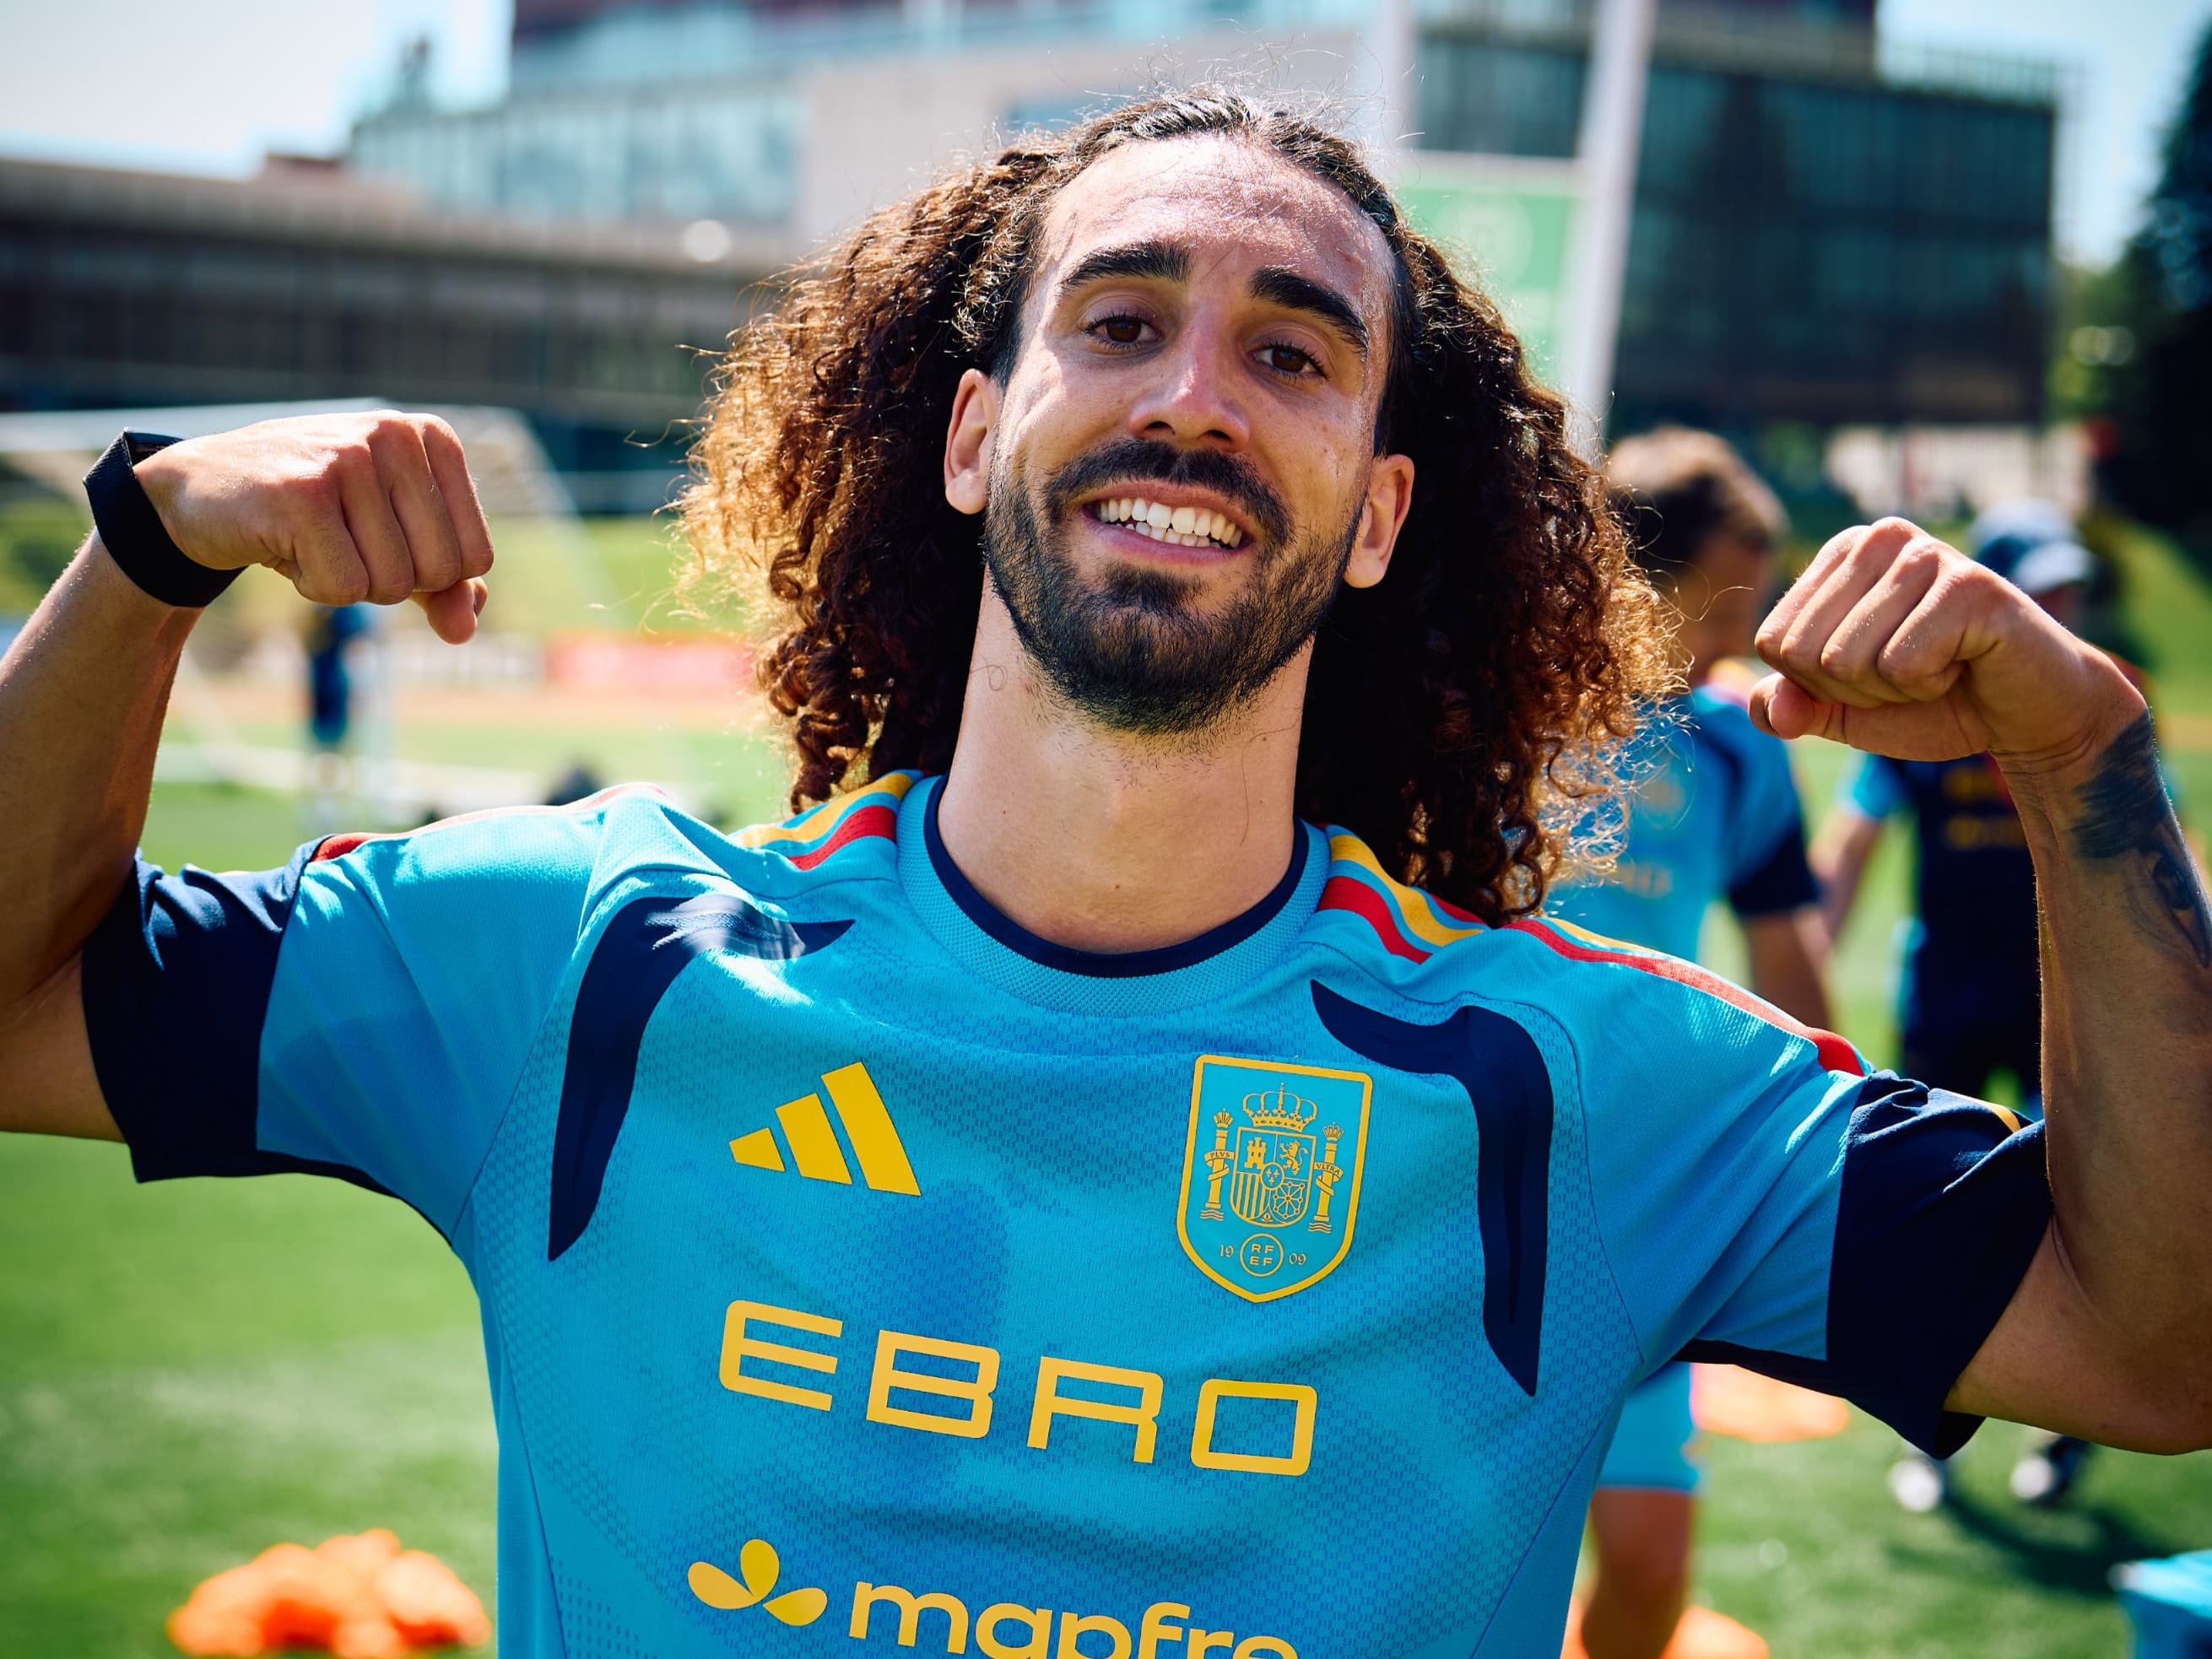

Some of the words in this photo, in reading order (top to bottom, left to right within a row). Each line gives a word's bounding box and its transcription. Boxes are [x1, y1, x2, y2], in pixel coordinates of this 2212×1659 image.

[1209, 1150, 1230, 1159] PLVS
[1316, 1163, 1341, 1175] VLTRA
[1220, 1244, 1235, 1257] 19
[1251, 1243, 1275, 1254] RF
[1249, 1256, 1274, 1266] EF
[1289, 1252, 1307, 1266] 09
[719, 1300, 1318, 1476] EBRO
